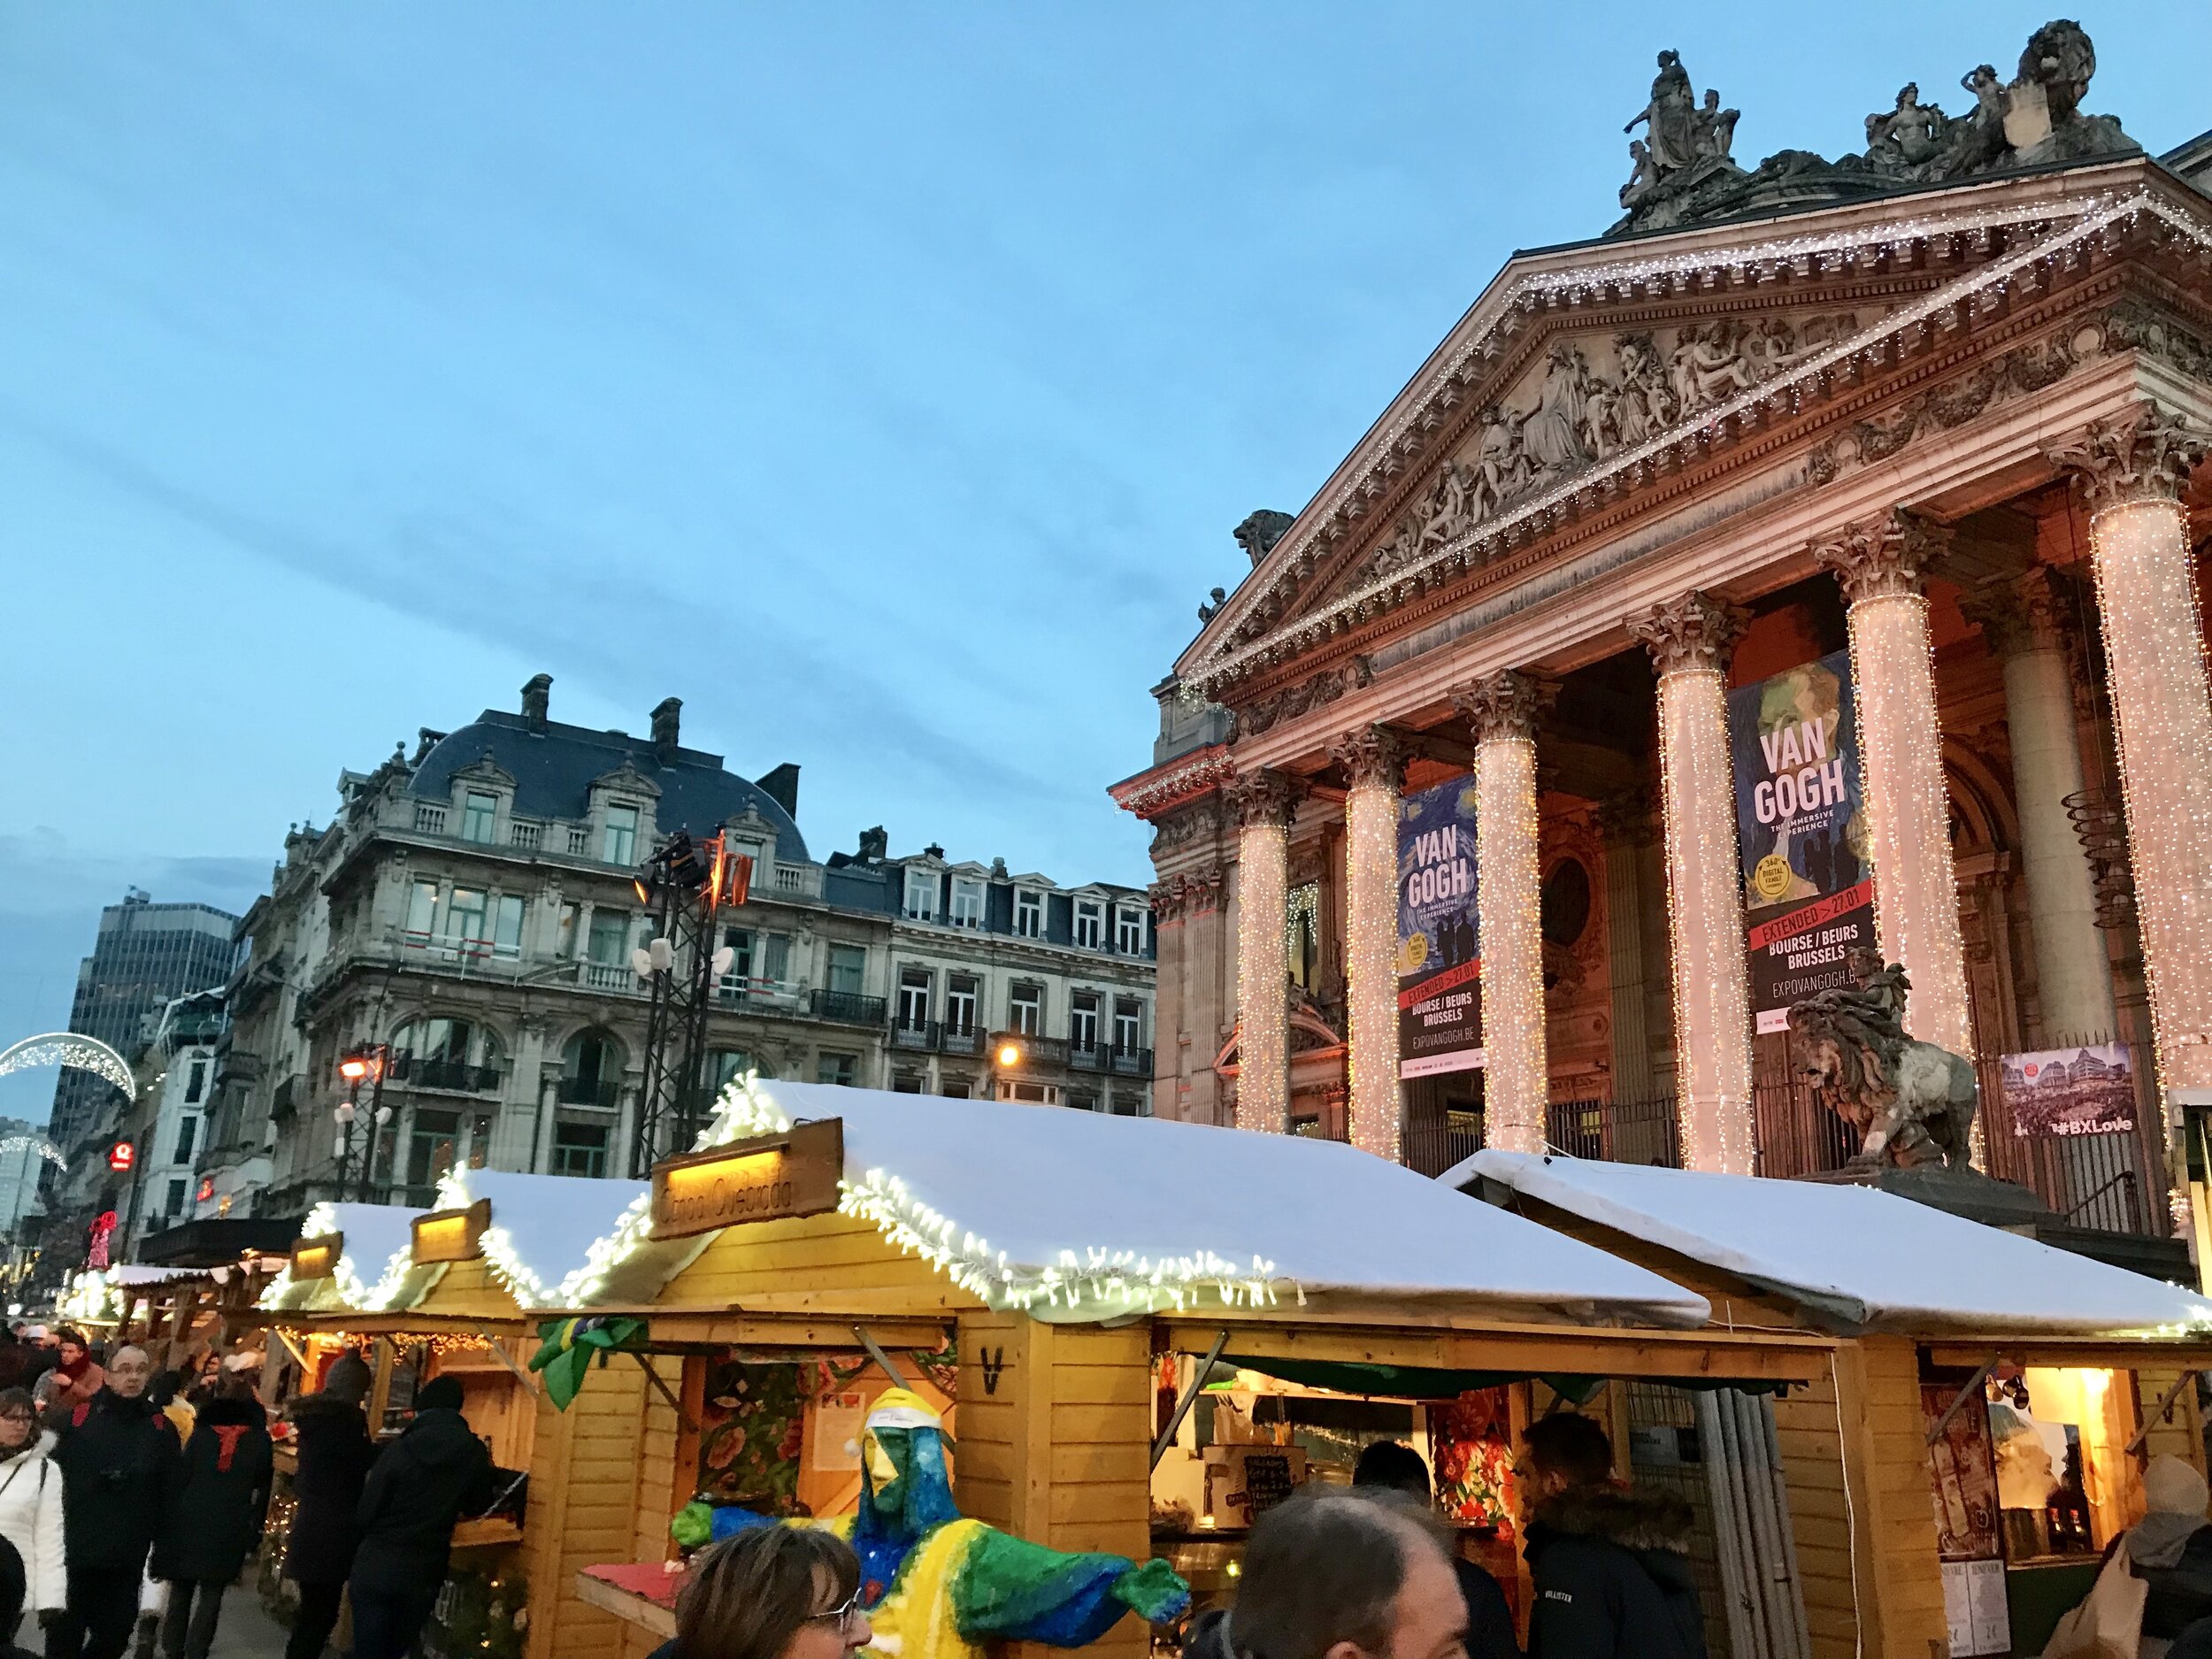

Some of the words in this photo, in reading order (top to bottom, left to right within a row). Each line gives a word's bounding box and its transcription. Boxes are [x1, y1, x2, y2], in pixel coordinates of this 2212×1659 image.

[1760, 717, 1826, 773] VAN
[1754, 759, 1846, 824] GOGH
[1787, 810, 1834, 828] IMMERSIVE
[1416, 824, 1456, 867] VAN
[1409, 858, 1467, 908] GOGH
[1763, 867, 1784, 877] DIGITAL
[1427, 899, 1457, 911] IMMERSIVE
[1762, 908, 1818, 942] EXTENDED
[1832, 889, 1861, 914] 27.01
[1769, 933, 1814, 956] BOURSE
[1822, 923, 1858, 944] BEURS
[1788, 944, 1846, 970] BRUSSELS
[1408, 977, 1444, 1004] EXTENDED
[1454, 964, 1474, 984] 27.01
[1772, 969, 1859, 998] EXPOVANGOGH.B
[1412, 998, 1440, 1016] BOURSE
[1446, 992, 1472, 1010] BEURS
[1424, 1009, 1463, 1027] BRUSSELS
[1413, 1026, 1474, 1050] EXPOVANGOGH.BE
